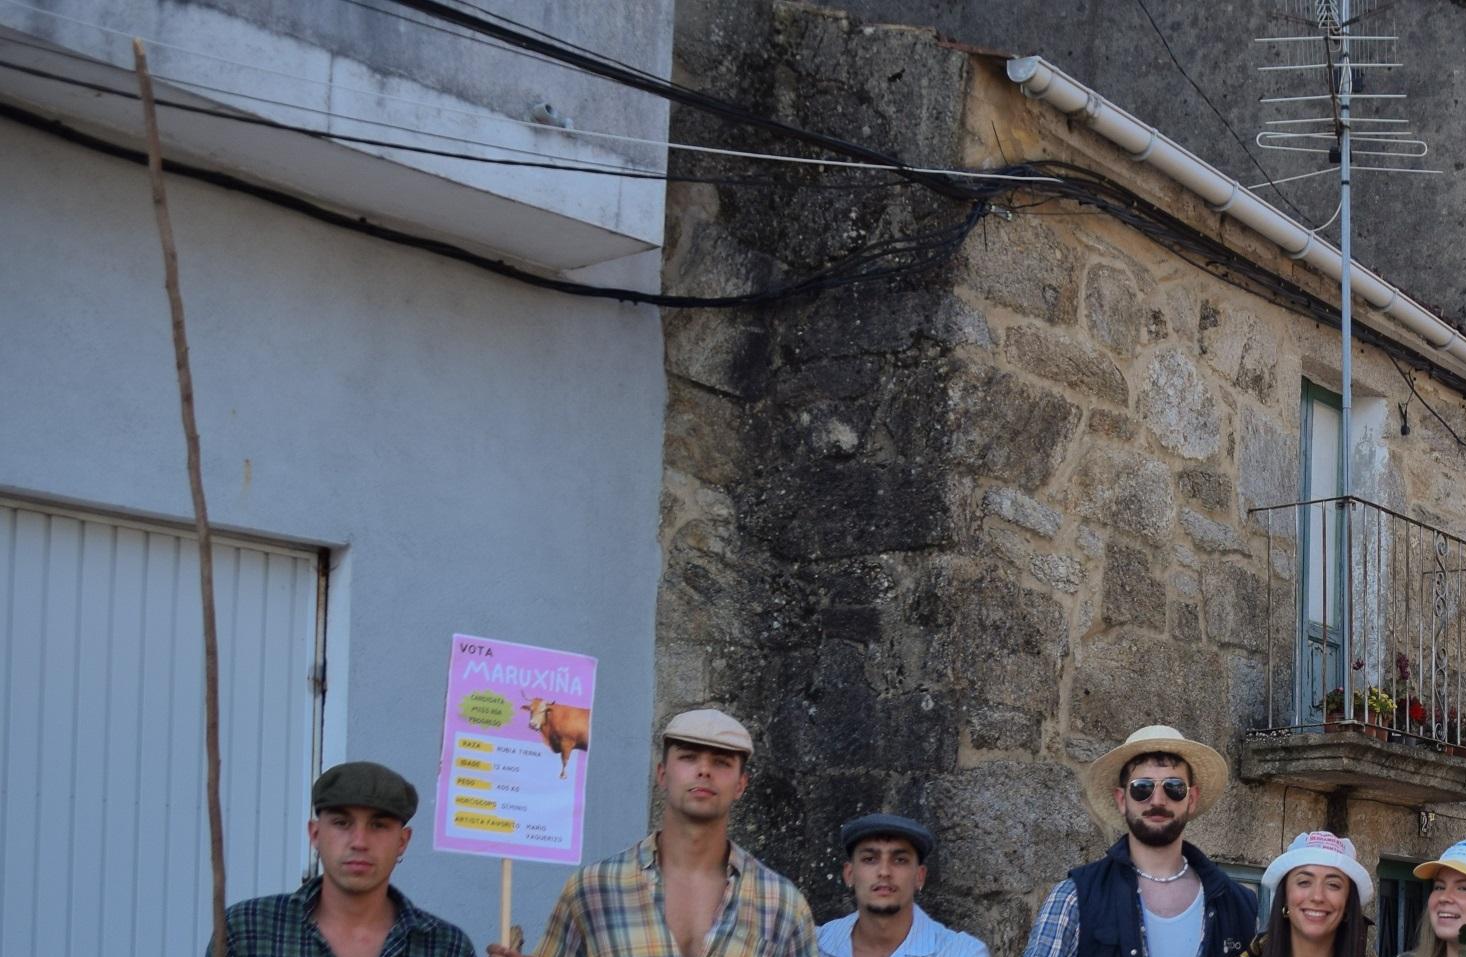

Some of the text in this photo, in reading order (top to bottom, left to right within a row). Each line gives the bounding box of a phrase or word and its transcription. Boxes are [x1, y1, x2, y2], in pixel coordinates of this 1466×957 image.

[460, 643, 493, 657] VOTA
[462, 660, 583, 697] MARUXIÑA
[457, 778, 475, 786] PESO
[454, 816, 520, 830] ARTISTA FAVORITO
